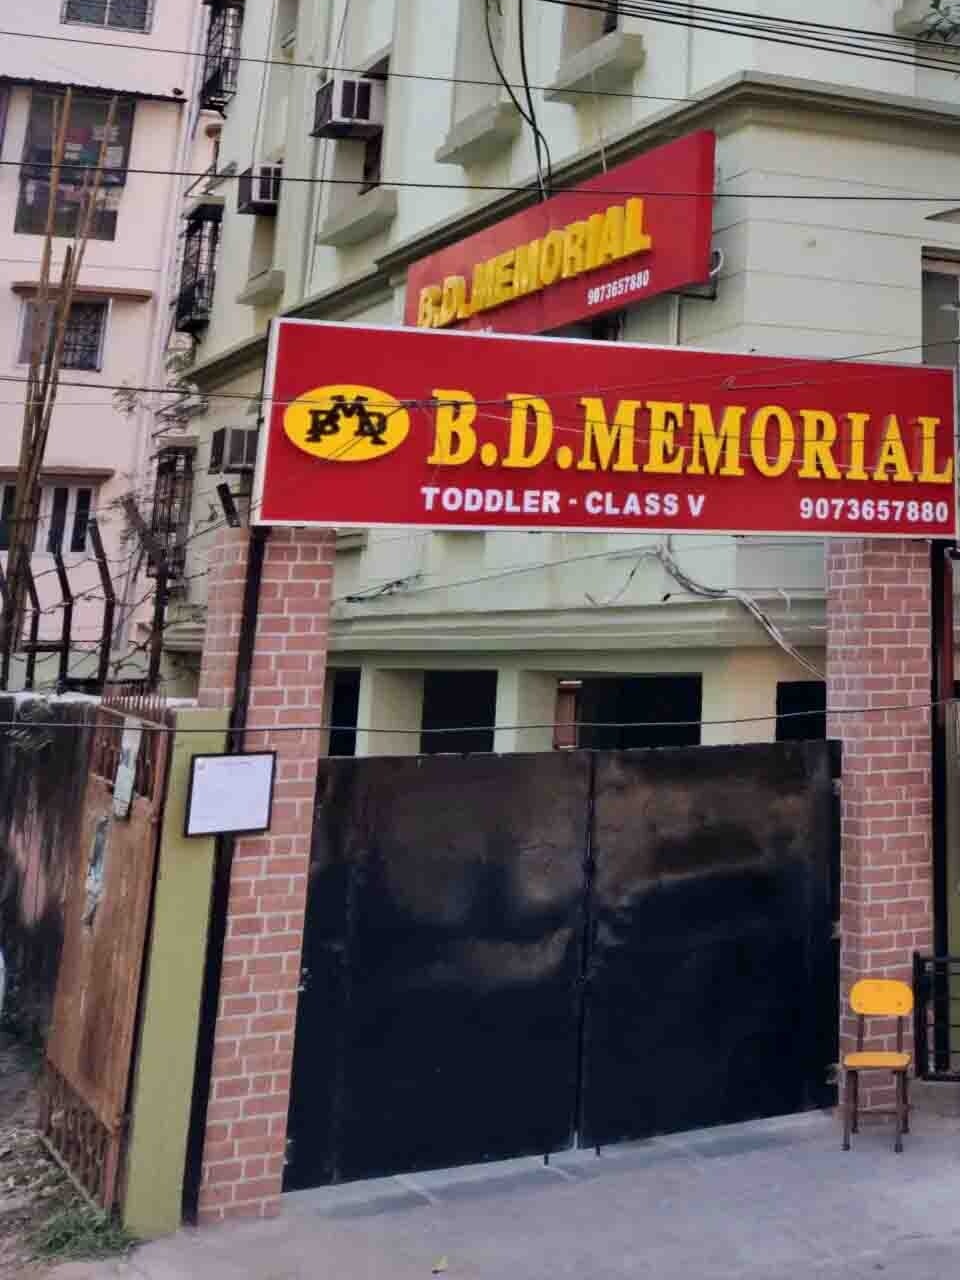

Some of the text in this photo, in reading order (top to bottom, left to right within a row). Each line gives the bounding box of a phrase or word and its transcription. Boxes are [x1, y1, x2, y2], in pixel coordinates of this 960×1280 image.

[586, 269, 650, 305] 9073657880
[420, 486, 561, 513] TODDLER
[584, 491, 679, 516] CLASS
[687, 494, 705, 517] V
[800, 497, 949, 523] 9073657880
